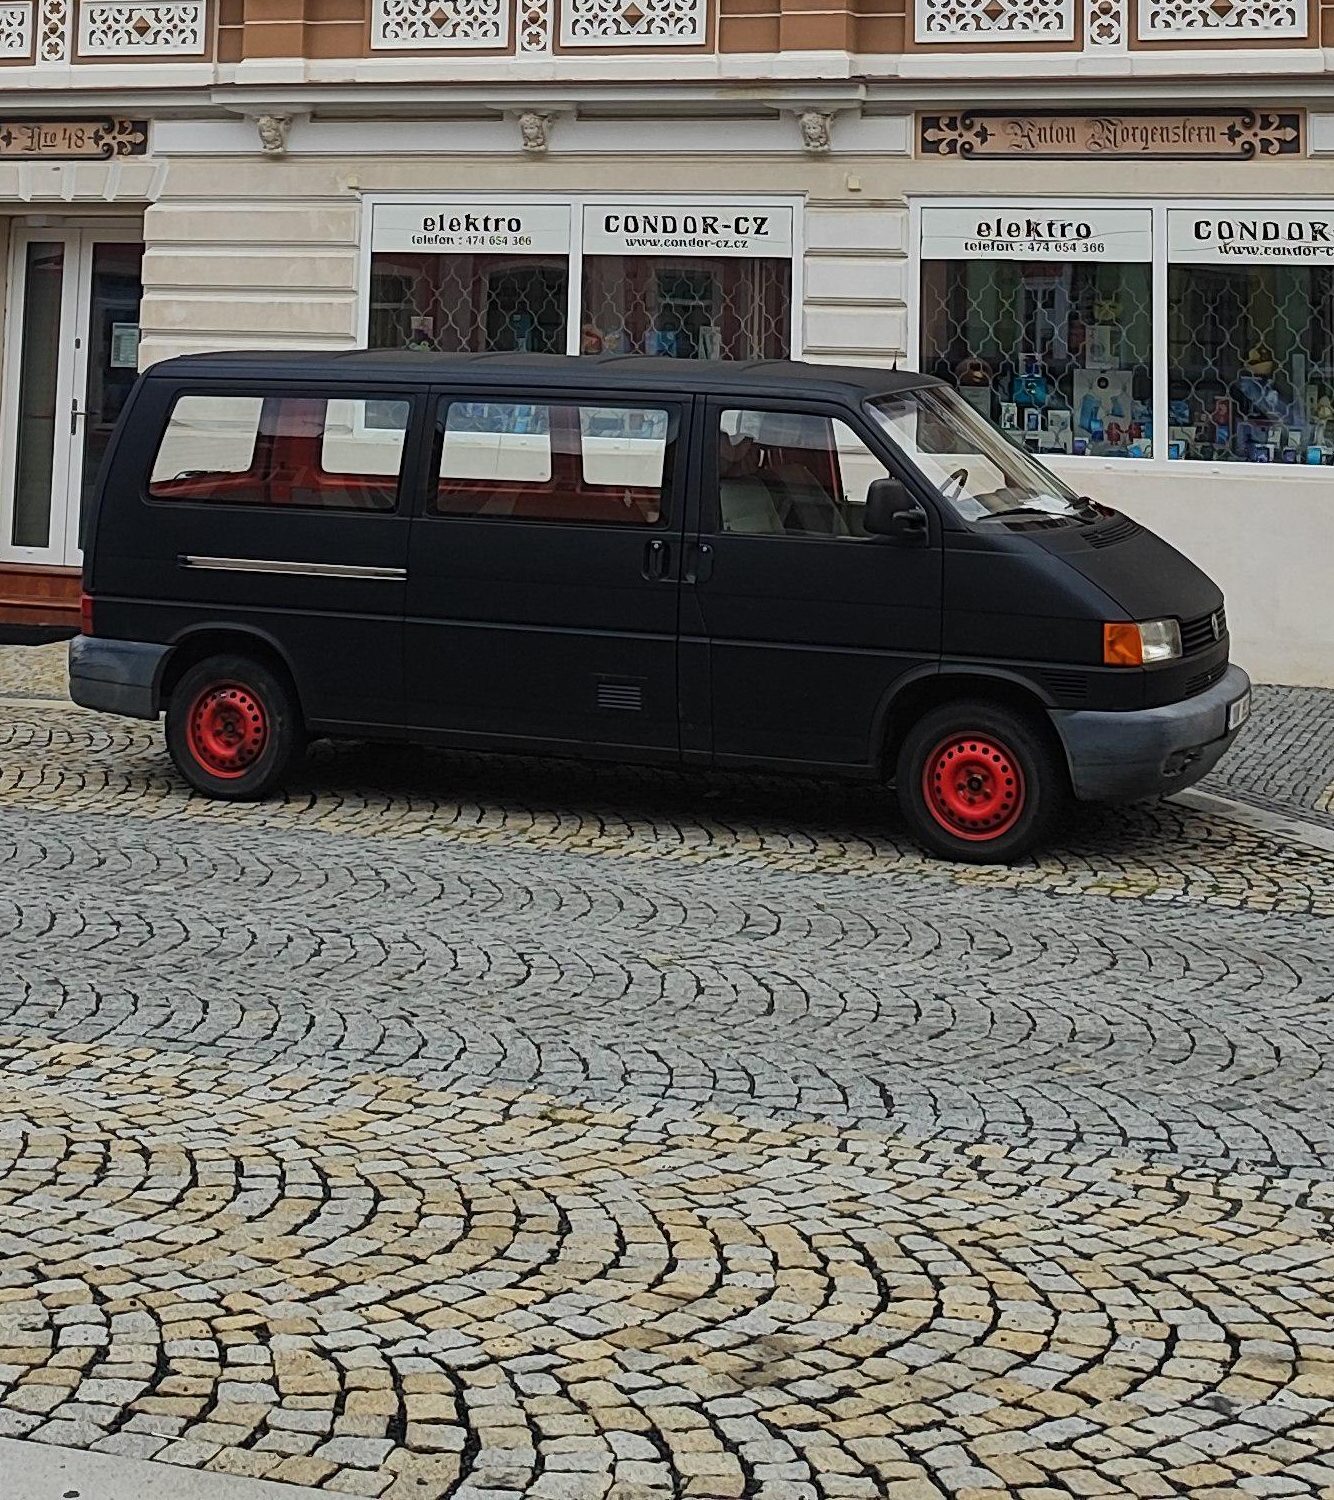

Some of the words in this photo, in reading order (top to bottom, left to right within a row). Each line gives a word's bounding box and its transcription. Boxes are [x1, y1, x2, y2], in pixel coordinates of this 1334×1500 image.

[62, 128, 85, 149] 48
[1002, 118, 1076, 150] Anton
[1085, 118, 1216, 151] Morgenstern
[423, 213, 521, 232] elektro
[604, 215, 769, 235] CONDOR-CZ
[976, 218, 1092, 239] elektro
[625, 237, 749, 249] www.condor-cz.cz
[964, 241, 1015, 252] telefon
[1027, 242, 1050, 252] 474
[1081, 242, 1105, 253] 366
